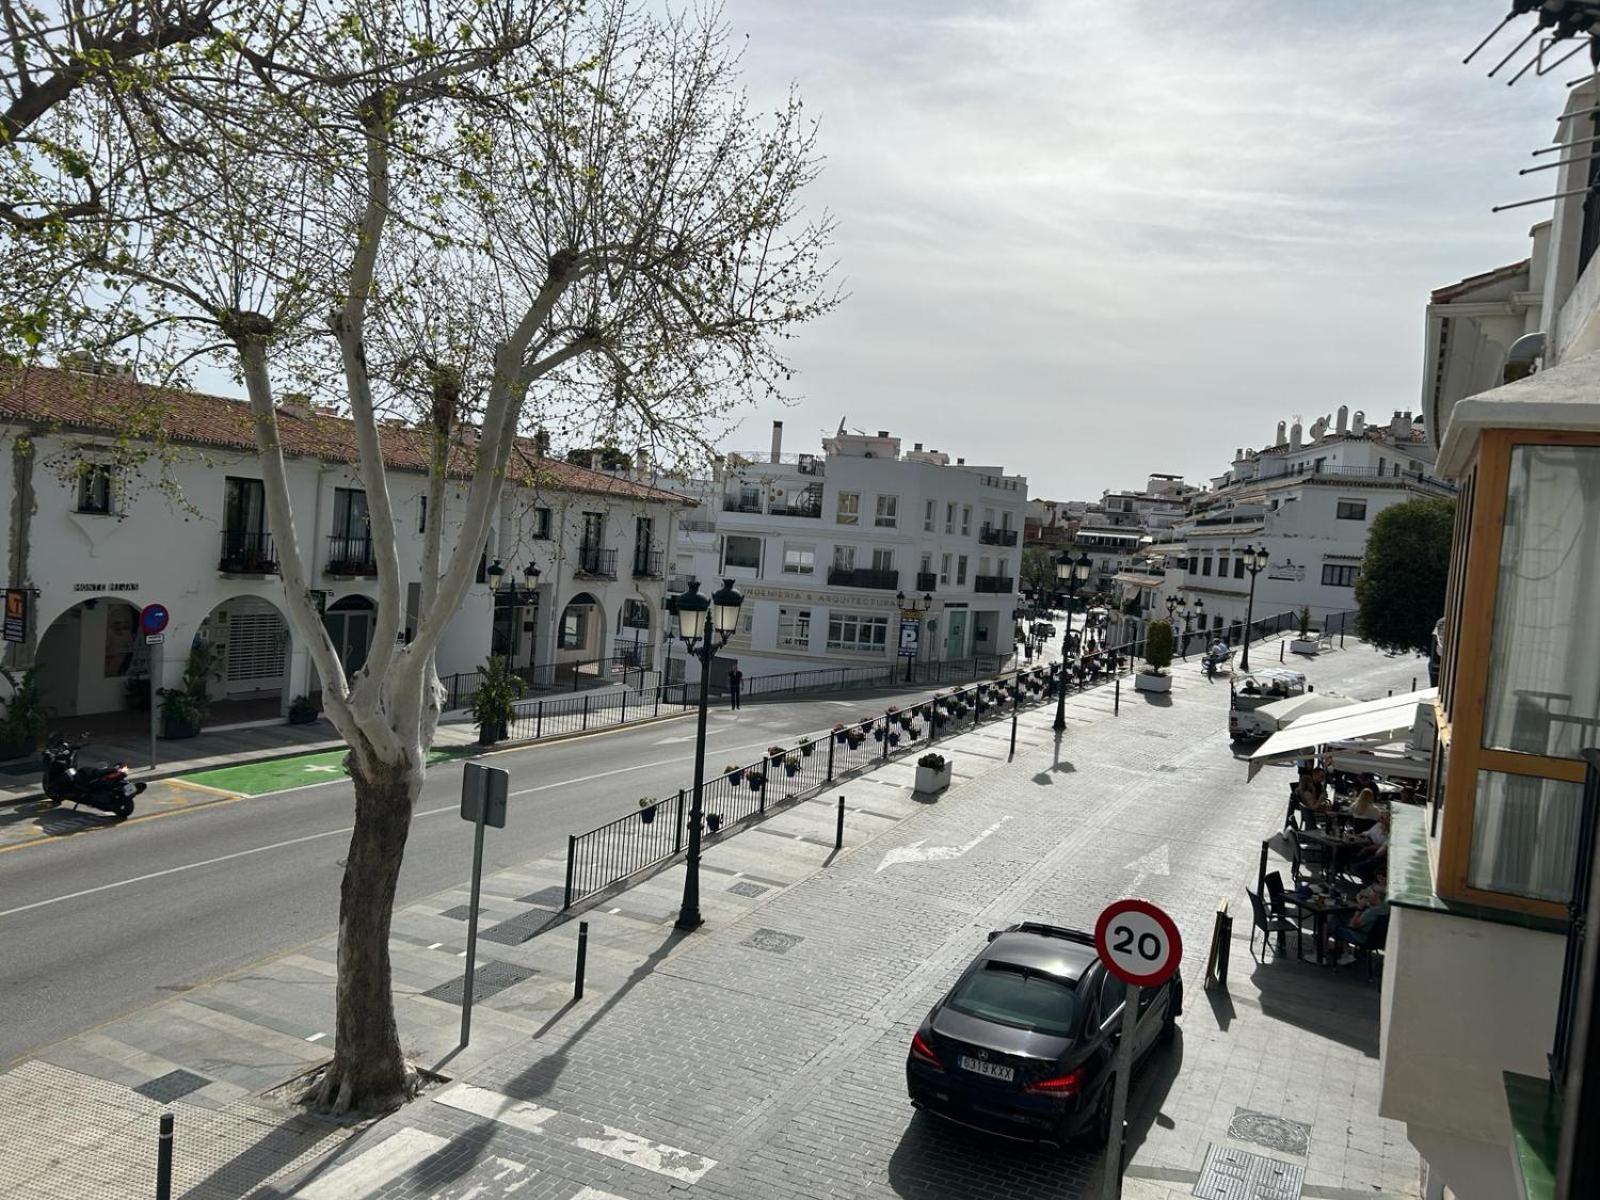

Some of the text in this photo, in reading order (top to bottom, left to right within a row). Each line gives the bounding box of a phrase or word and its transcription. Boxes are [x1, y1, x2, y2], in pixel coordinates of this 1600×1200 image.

[817, 595, 897, 608] ARQUITECTURA
[902, 629, 917, 647] P
[1112, 925, 1161, 961] 20
